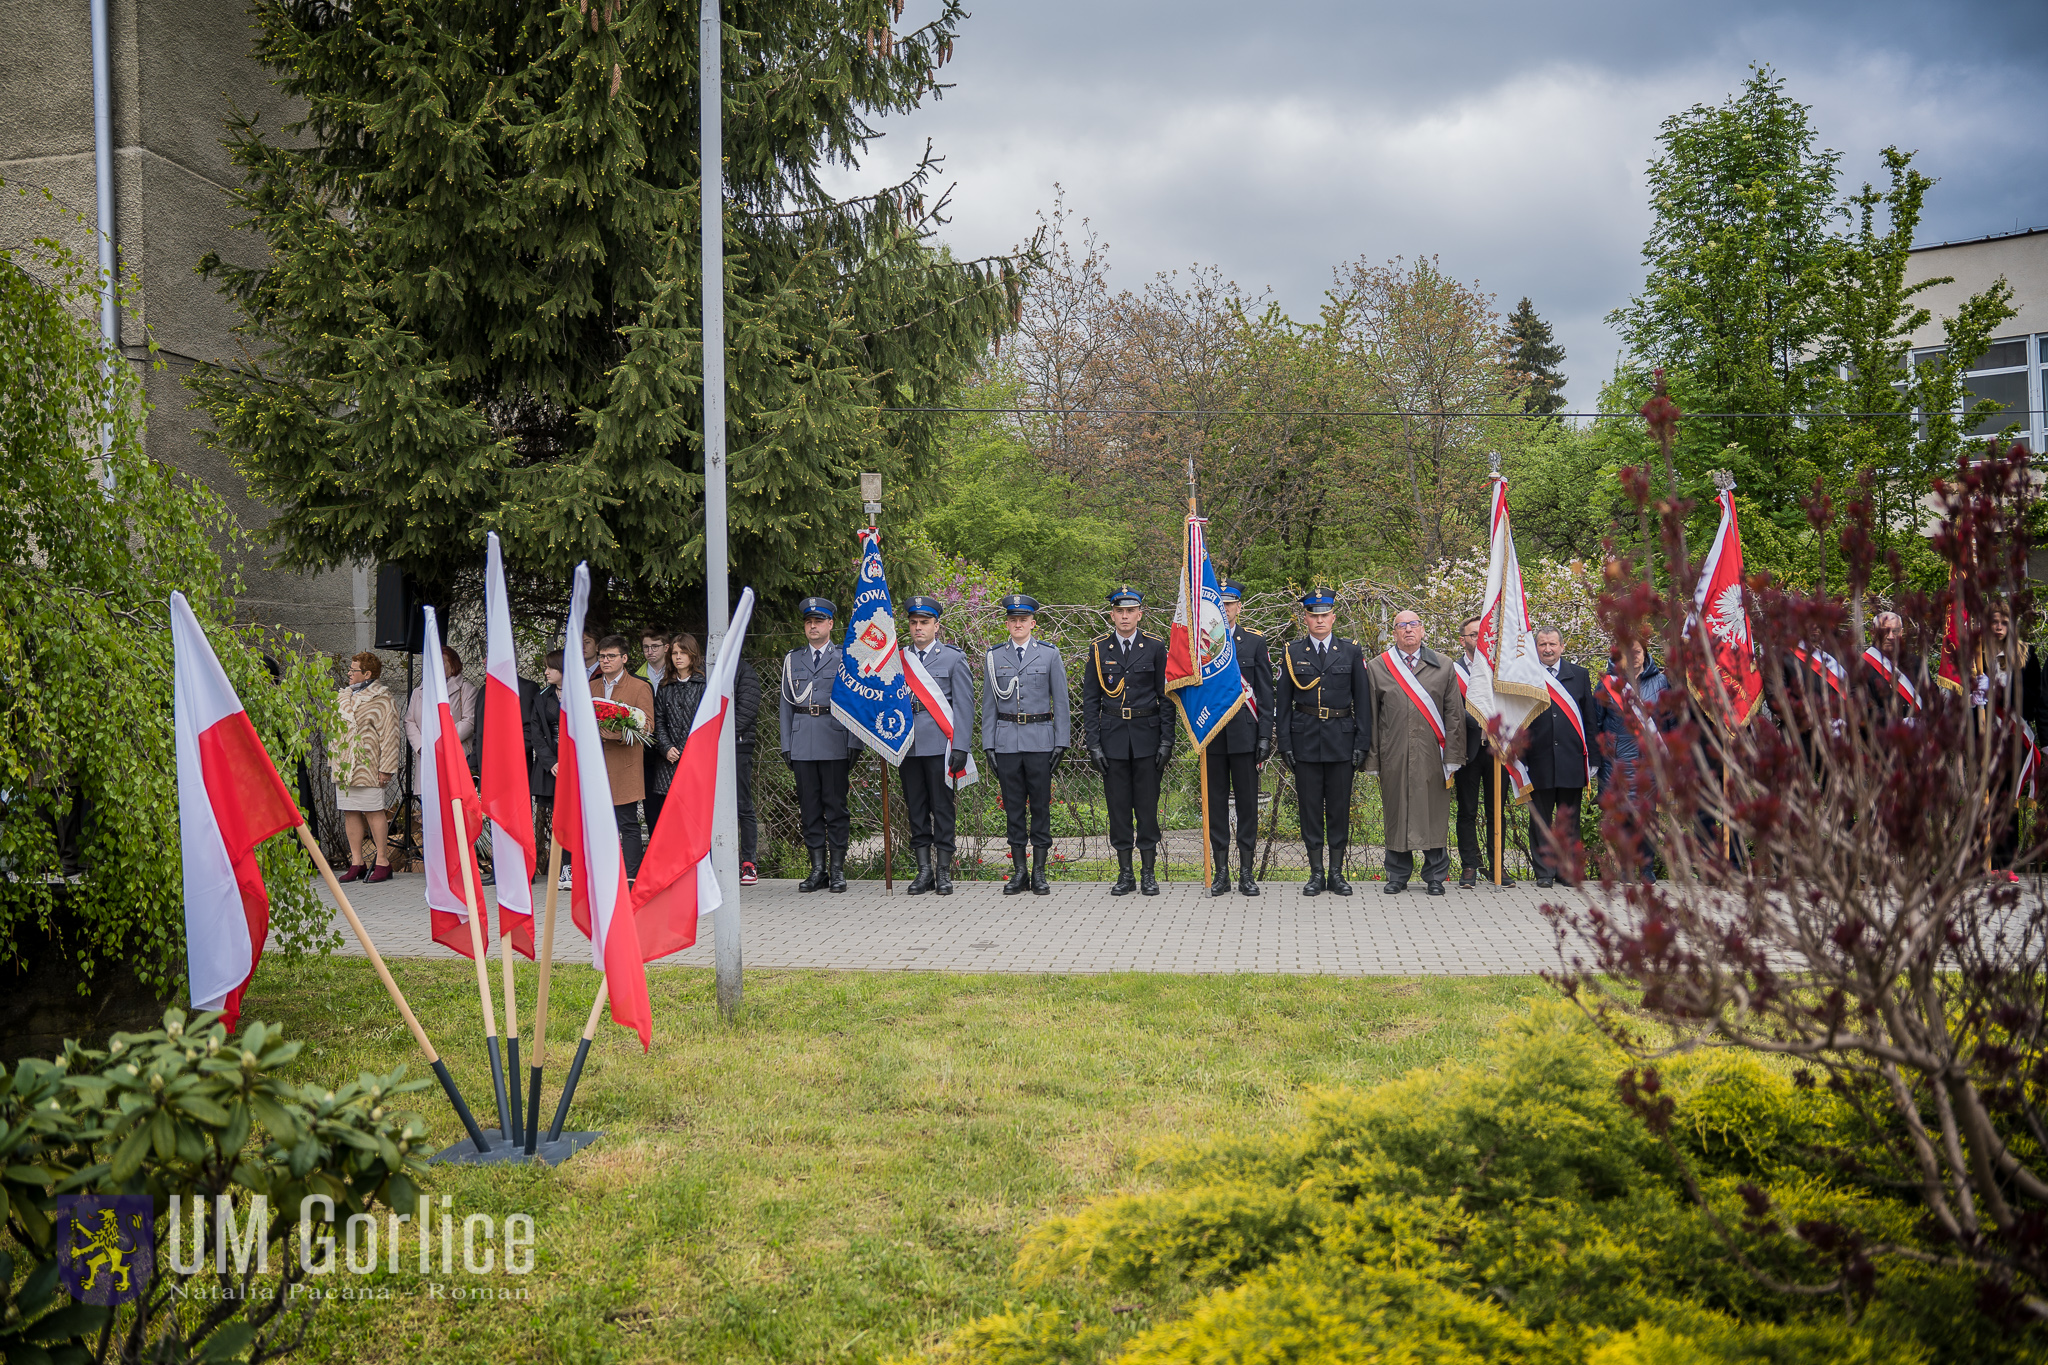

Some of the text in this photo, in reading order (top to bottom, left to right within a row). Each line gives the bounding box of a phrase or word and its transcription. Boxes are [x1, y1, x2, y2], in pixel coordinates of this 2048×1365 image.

[1204, 666, 1212, 675] w
[1196, 705, 1211, 728] 1867
[888, 717, 896, 728] P
